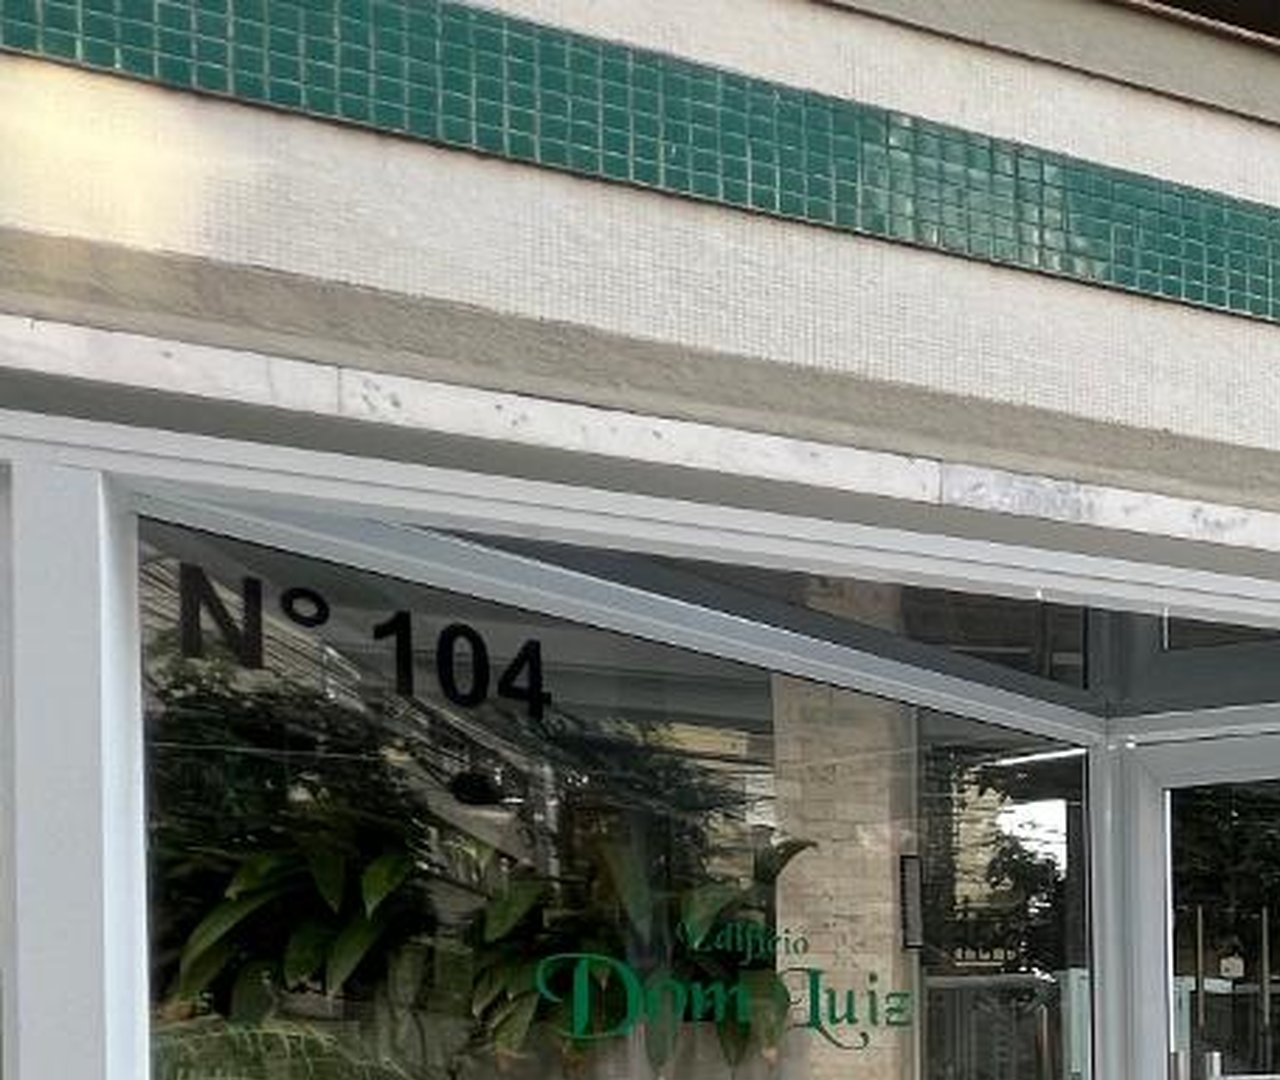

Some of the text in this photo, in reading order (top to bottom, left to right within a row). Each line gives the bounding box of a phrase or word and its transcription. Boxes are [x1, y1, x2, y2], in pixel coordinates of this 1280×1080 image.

[373, 610, 553, 722] 104
[536, 953, 912, 1050] Dom Luiz
